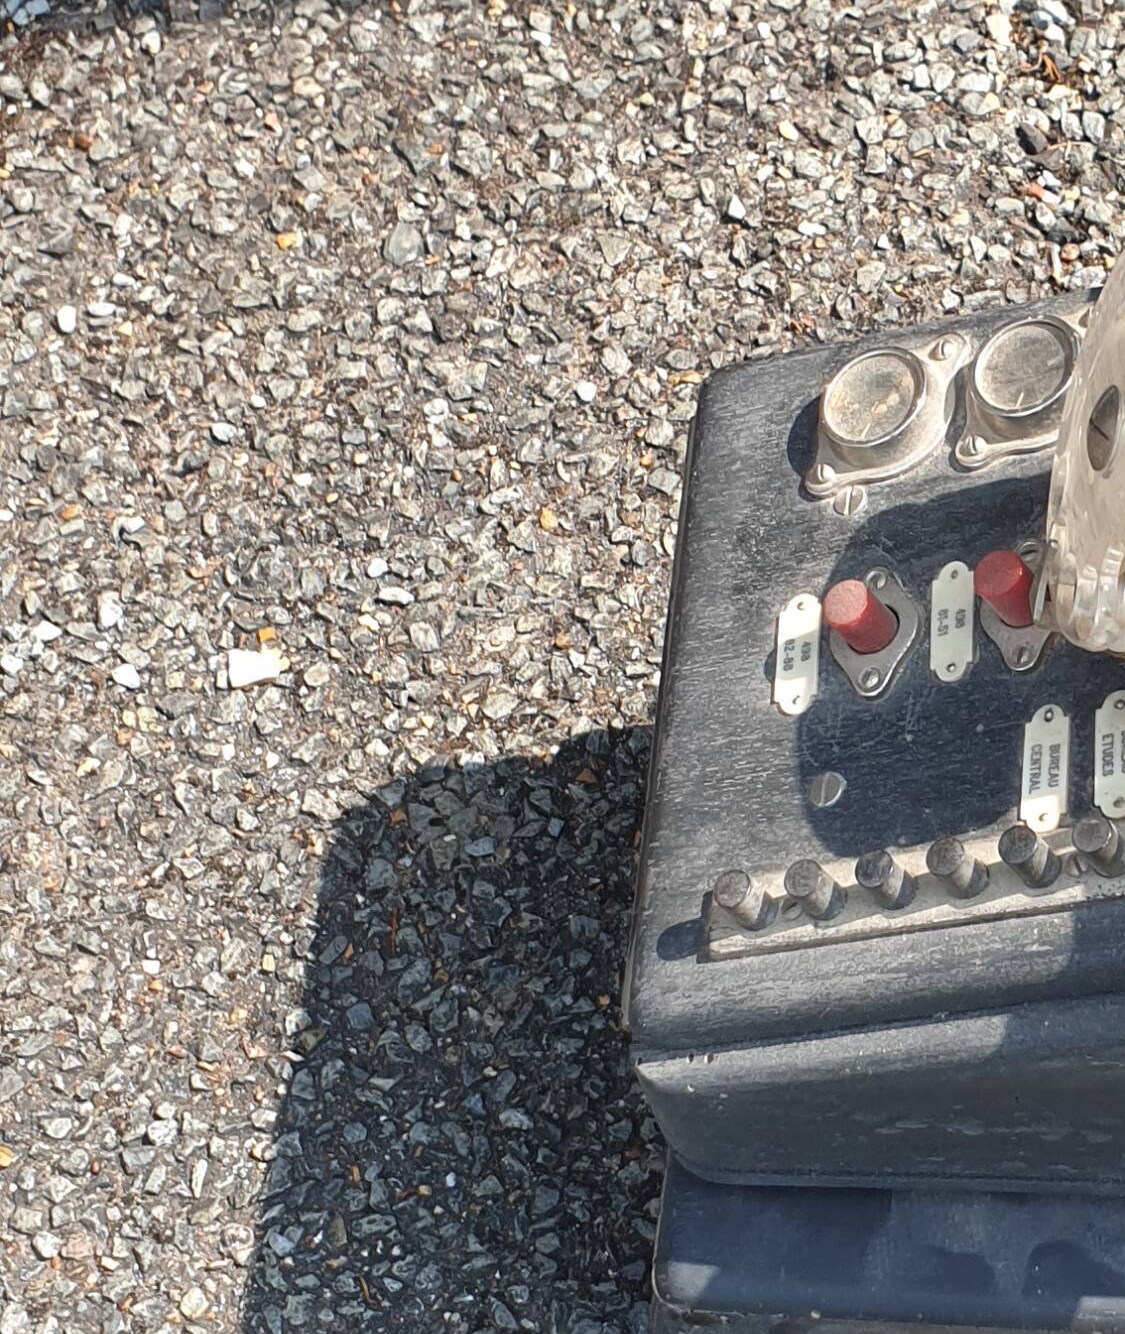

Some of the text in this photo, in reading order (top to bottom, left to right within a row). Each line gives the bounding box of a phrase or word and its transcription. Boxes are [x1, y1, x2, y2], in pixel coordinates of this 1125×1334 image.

[1028, 743, 1043, 795] CENTRAL
[1047, 743, 1061, 788] BUREAU
[1101, 733, 1115, 777] ETUDES
